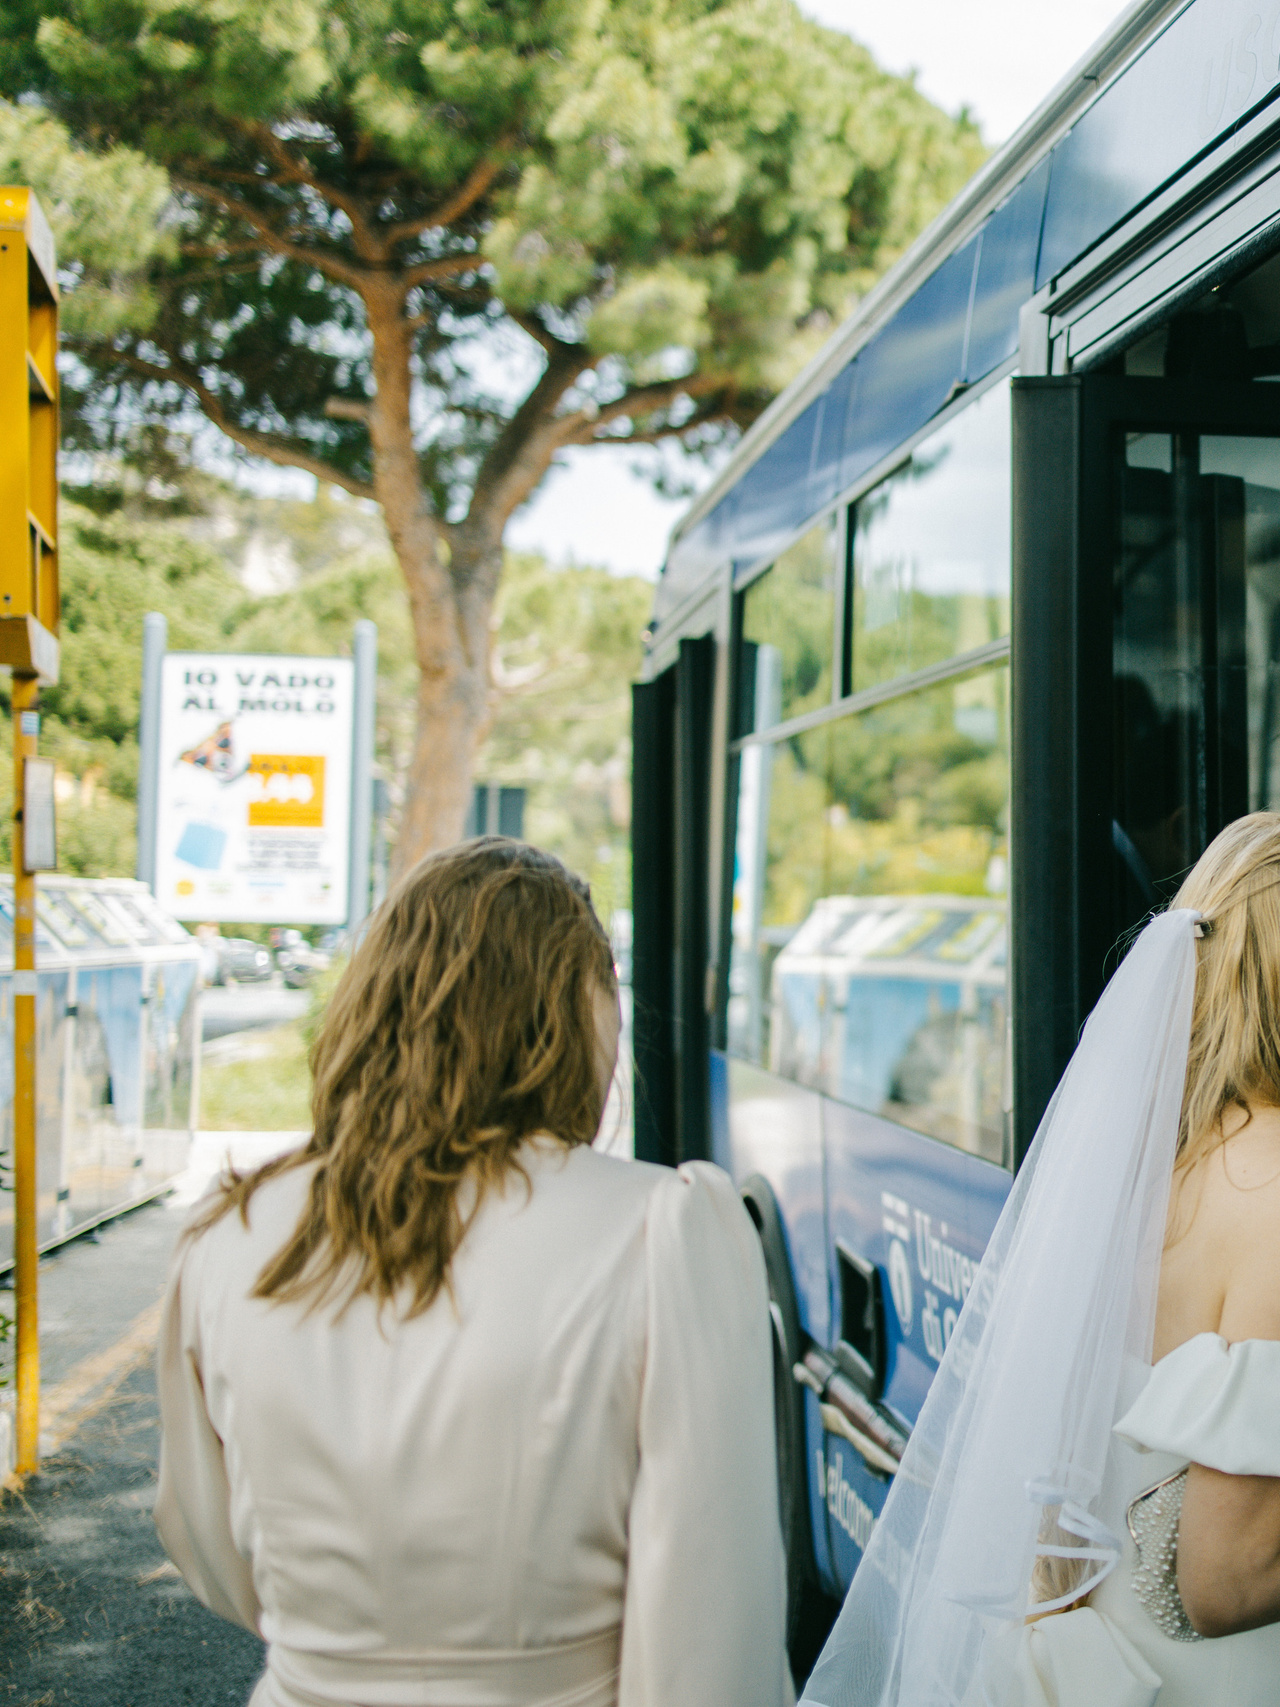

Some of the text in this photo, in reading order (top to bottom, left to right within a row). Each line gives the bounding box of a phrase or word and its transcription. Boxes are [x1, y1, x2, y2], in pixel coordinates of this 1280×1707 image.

[183, 669, 336, 690] IO VADO
[182, 694, 336, 714] AL MOLO
